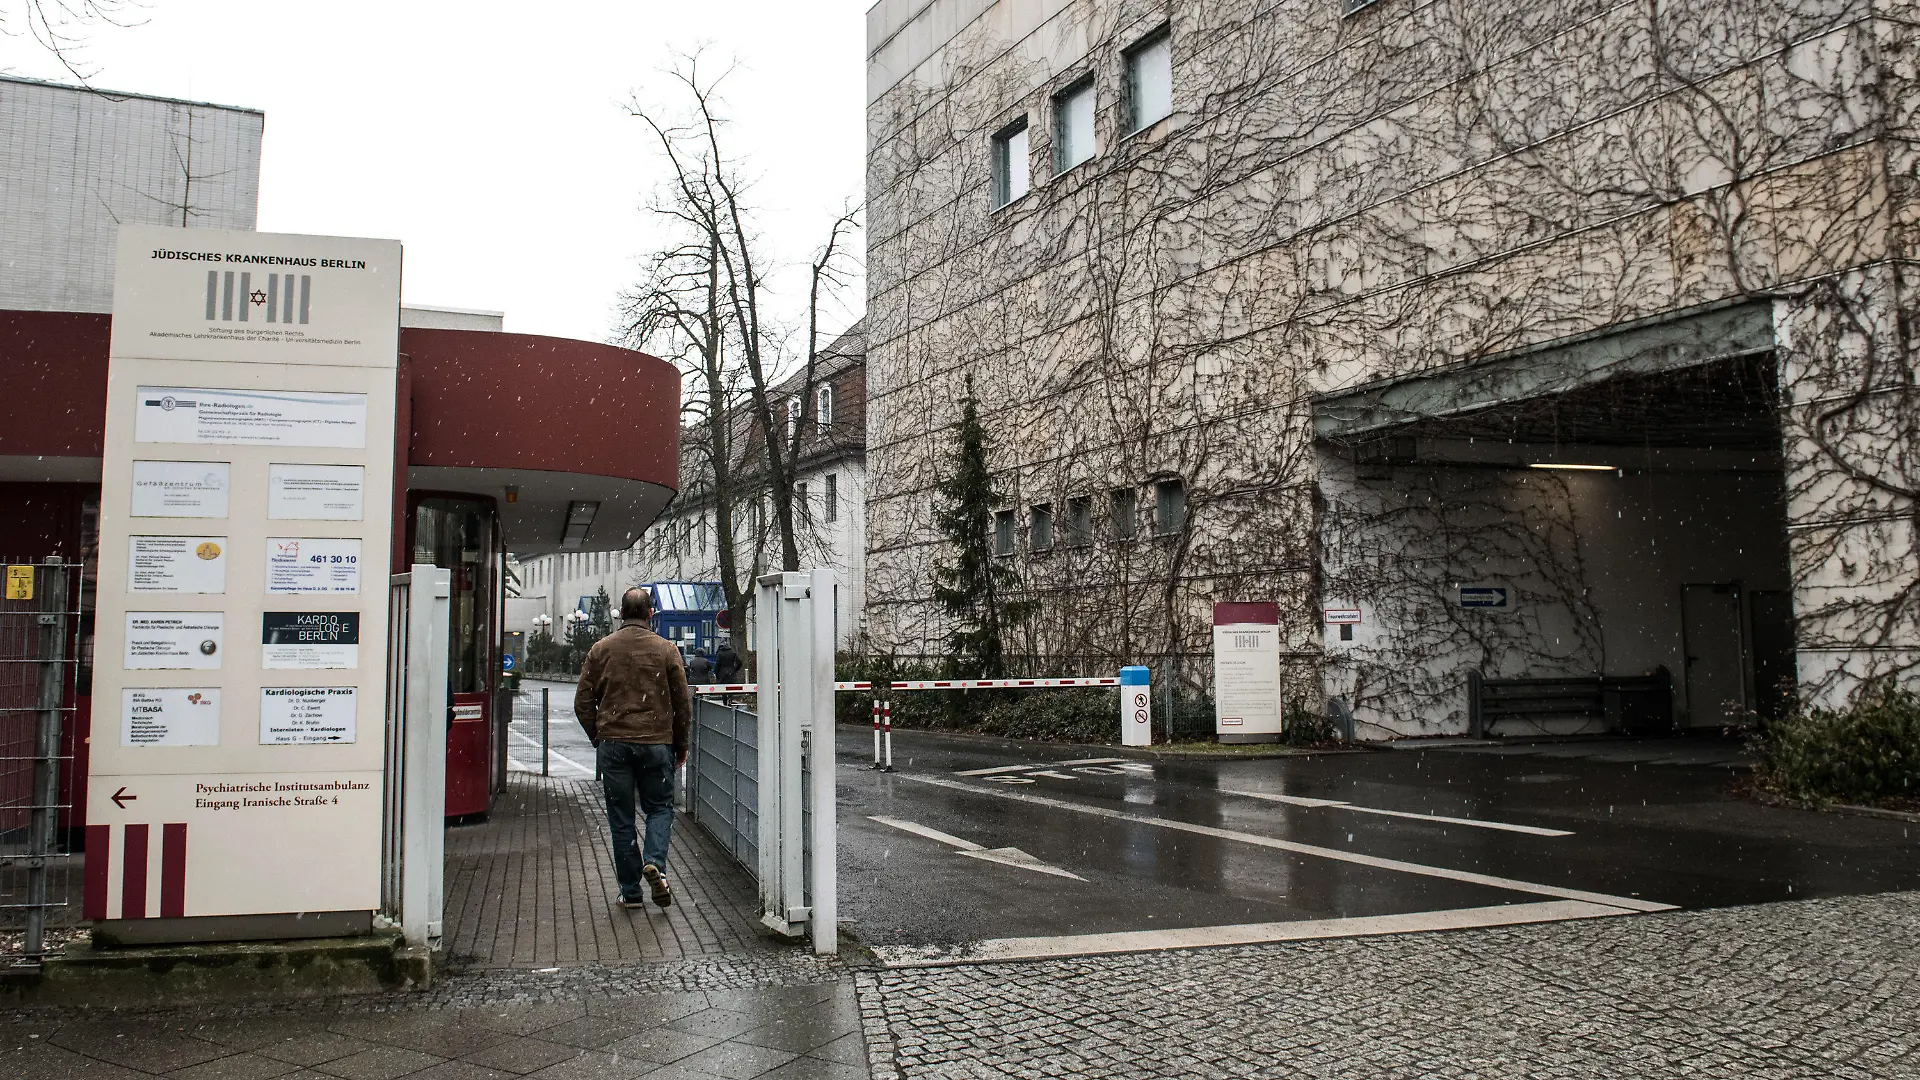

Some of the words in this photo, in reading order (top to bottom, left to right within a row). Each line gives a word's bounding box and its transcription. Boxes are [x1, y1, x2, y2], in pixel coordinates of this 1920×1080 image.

[151, 249, 222, 263] JÜDISCHES
[226, 254, 317, 267] KRANKENHAUS
[320, 259, 366, 270] BERLIN
[330, 555, 342, 563] 30
[298, 630, 338, 641] BERLIN
[196, 782, 272, 794] Psychiatrische
[274, 780, 370, 792] Institutsambulanz
[195, 797, 240, 811] Eingang
[242, 797, 292, 808] Iranische
[294, 796, 329, 807] Straße
[331, 796, 339, 805] 4
